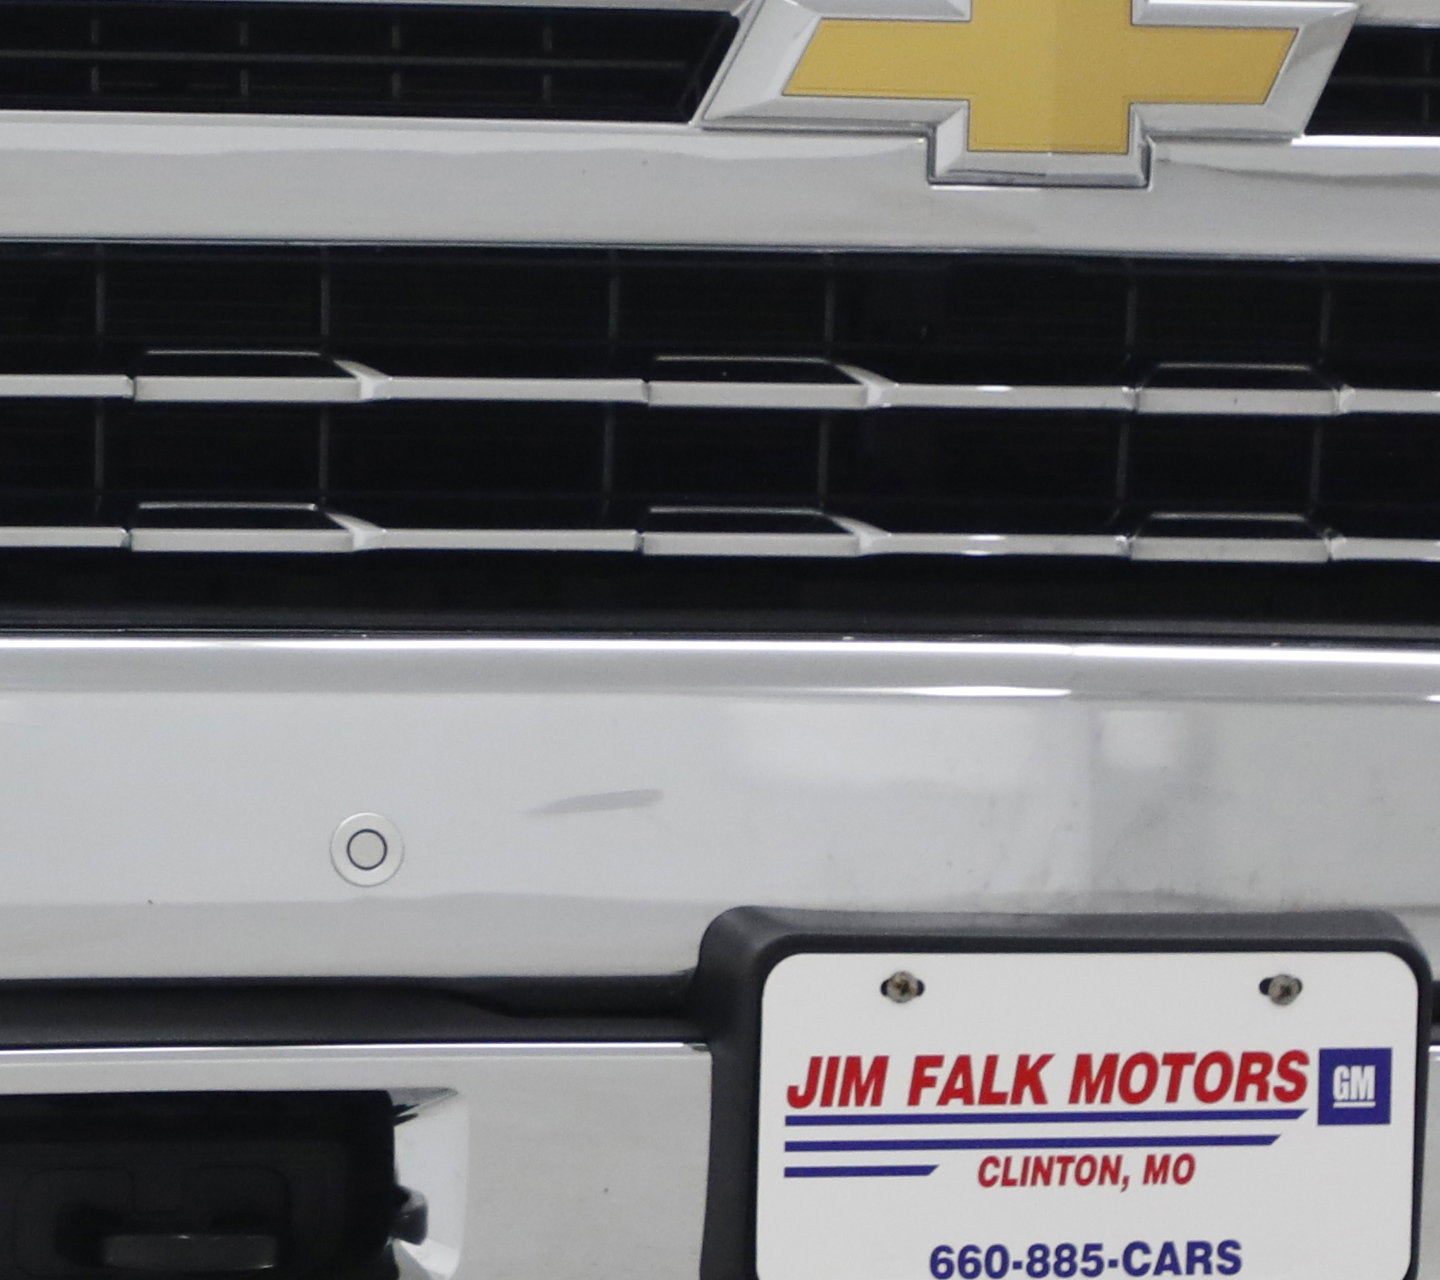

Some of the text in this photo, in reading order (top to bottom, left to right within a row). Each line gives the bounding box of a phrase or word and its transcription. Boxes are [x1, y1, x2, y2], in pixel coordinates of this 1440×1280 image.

[786, 1049, 1310, 1109] JIM FALK MOTORS
[1332, 1065, 1376, 1103] GM
[977, 1153, 1196, 1191] CLINTON, MO
[929, 1240, 1243, 1280] 660-885-CARS
